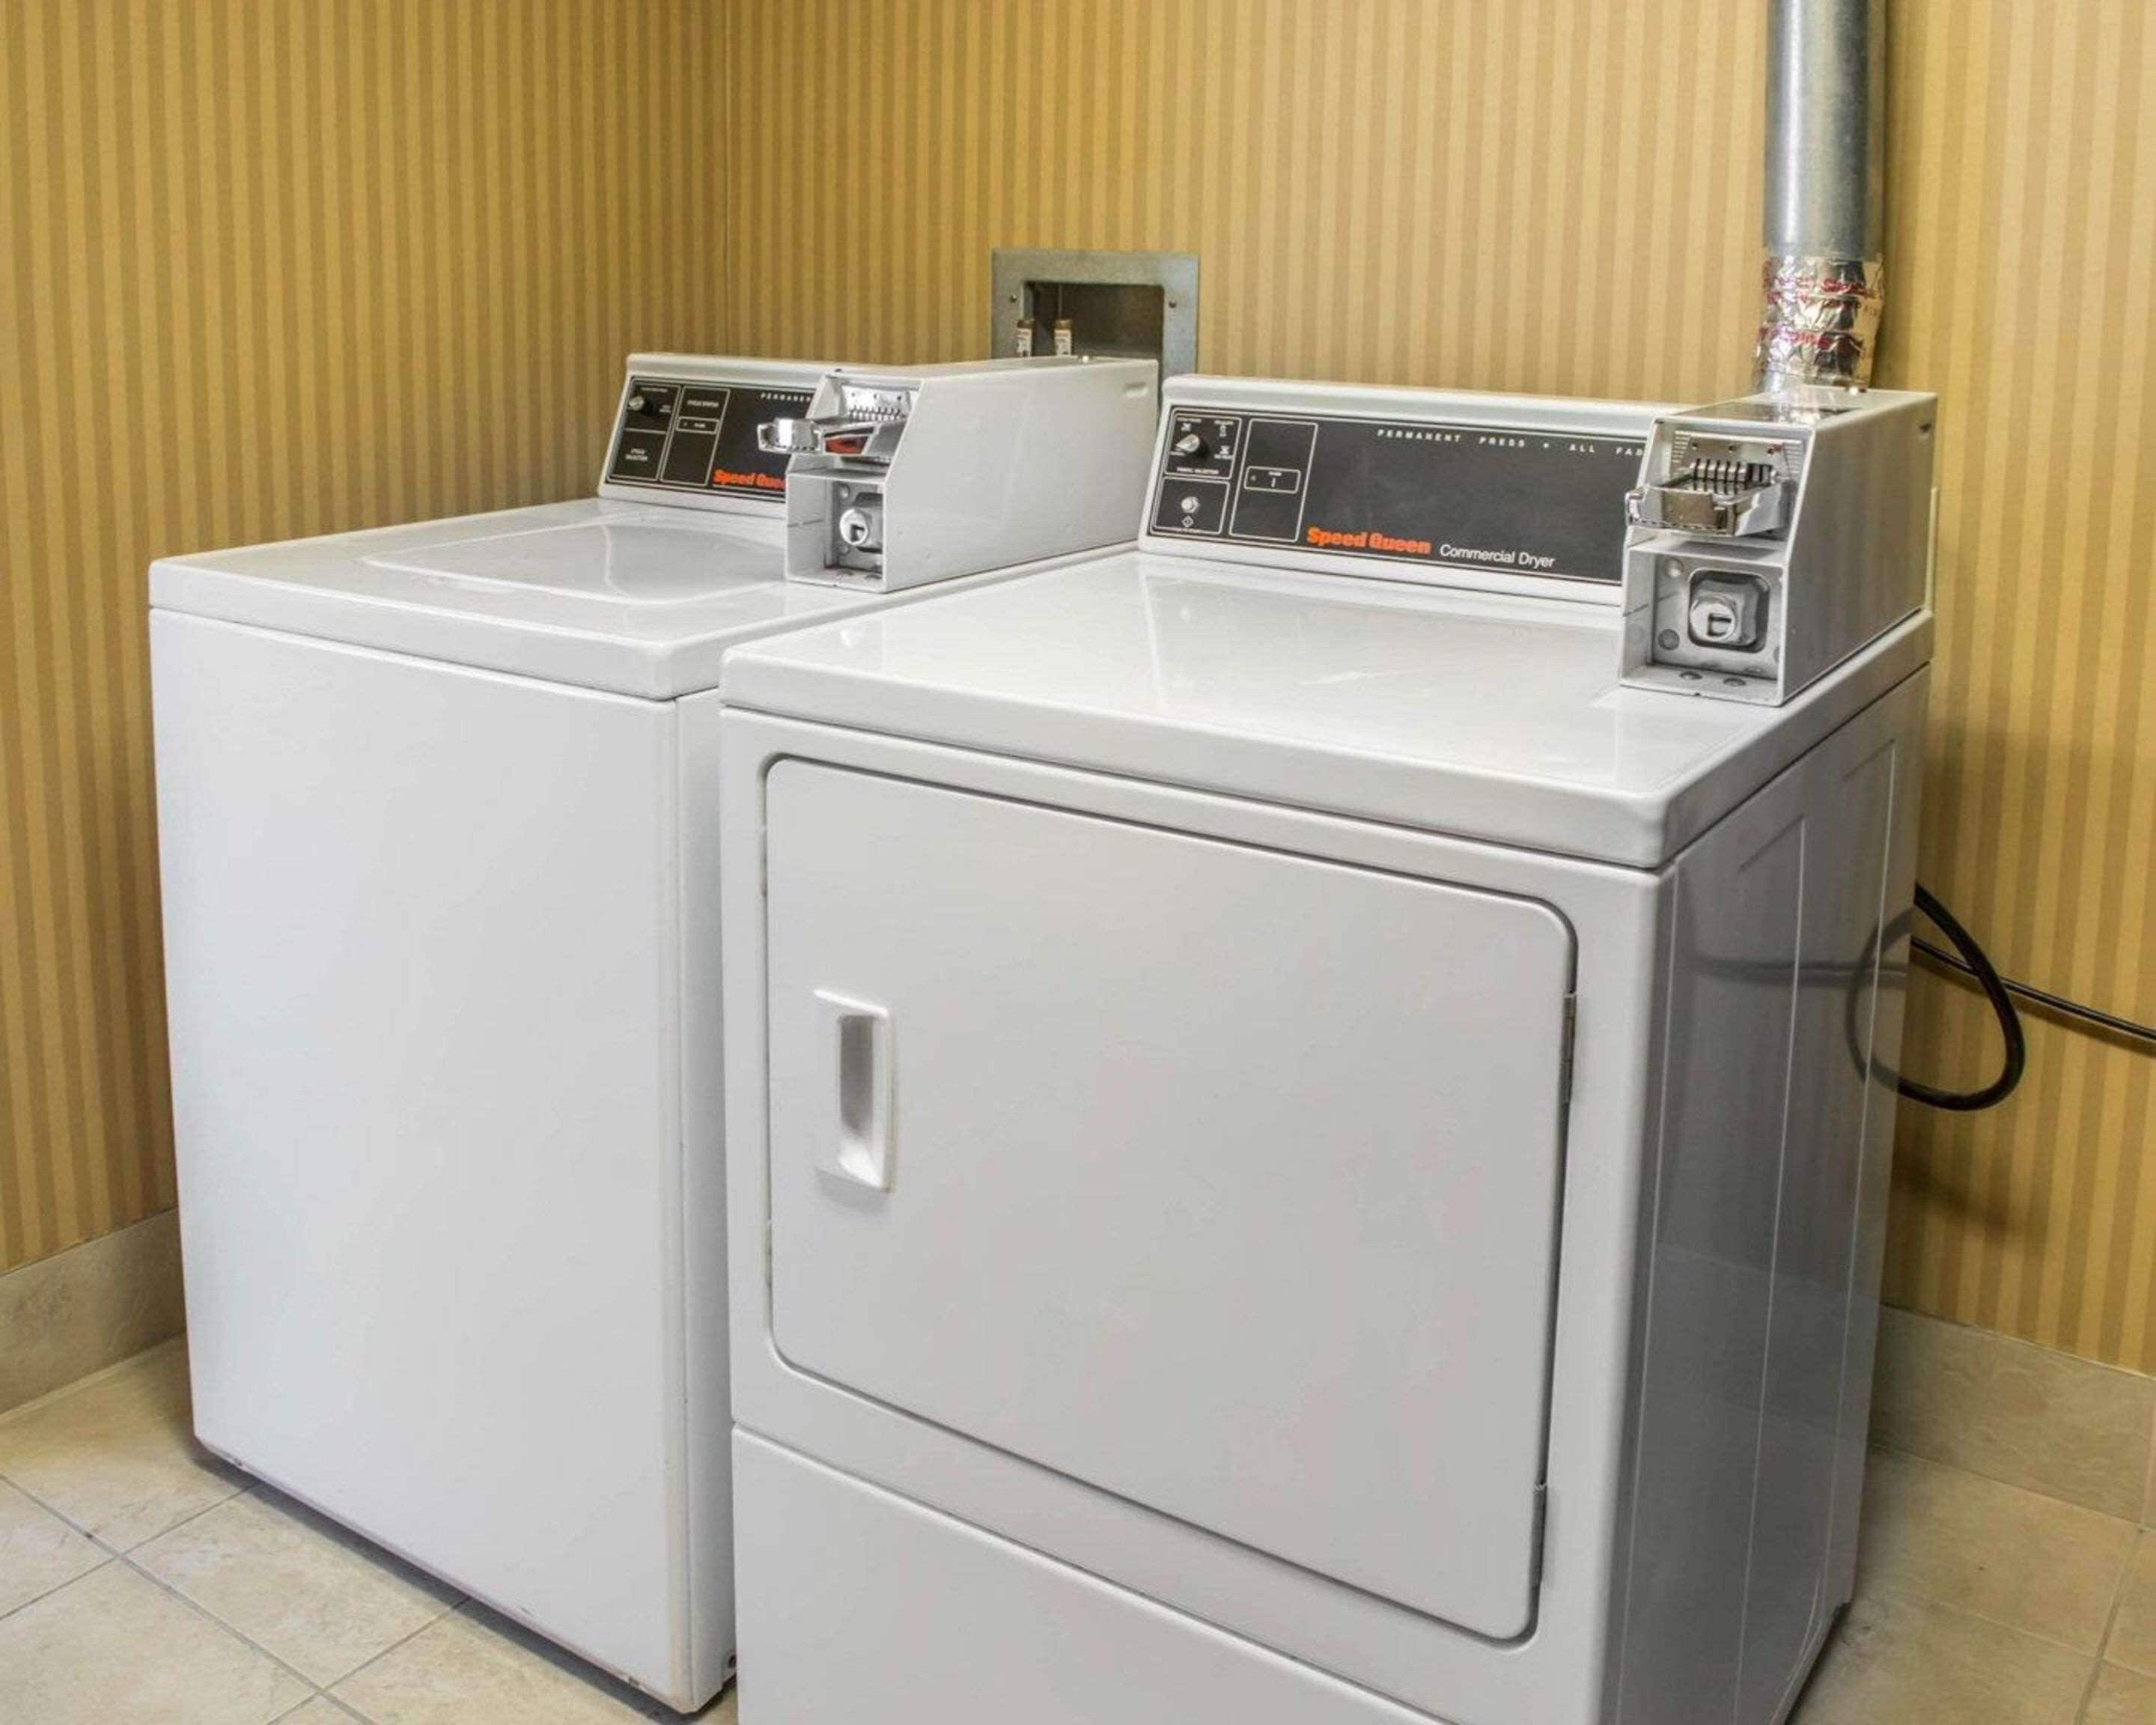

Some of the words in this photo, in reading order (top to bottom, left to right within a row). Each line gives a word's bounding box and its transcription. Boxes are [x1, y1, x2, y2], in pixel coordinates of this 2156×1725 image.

[1377, 429, 1461, 442] PERMANENT
[1479, 436, 1525, 448] PRESS
[1569, 444, 1595, 453] ALL
[713, 469, 755, 486] Speed
[1306, 526, 1368, 547] Speed
[1369, 532, 1432, 555] Queen
[1440, 544, 1516, 564] Commercial
[1517, 552, 1556, 570] Dryer
